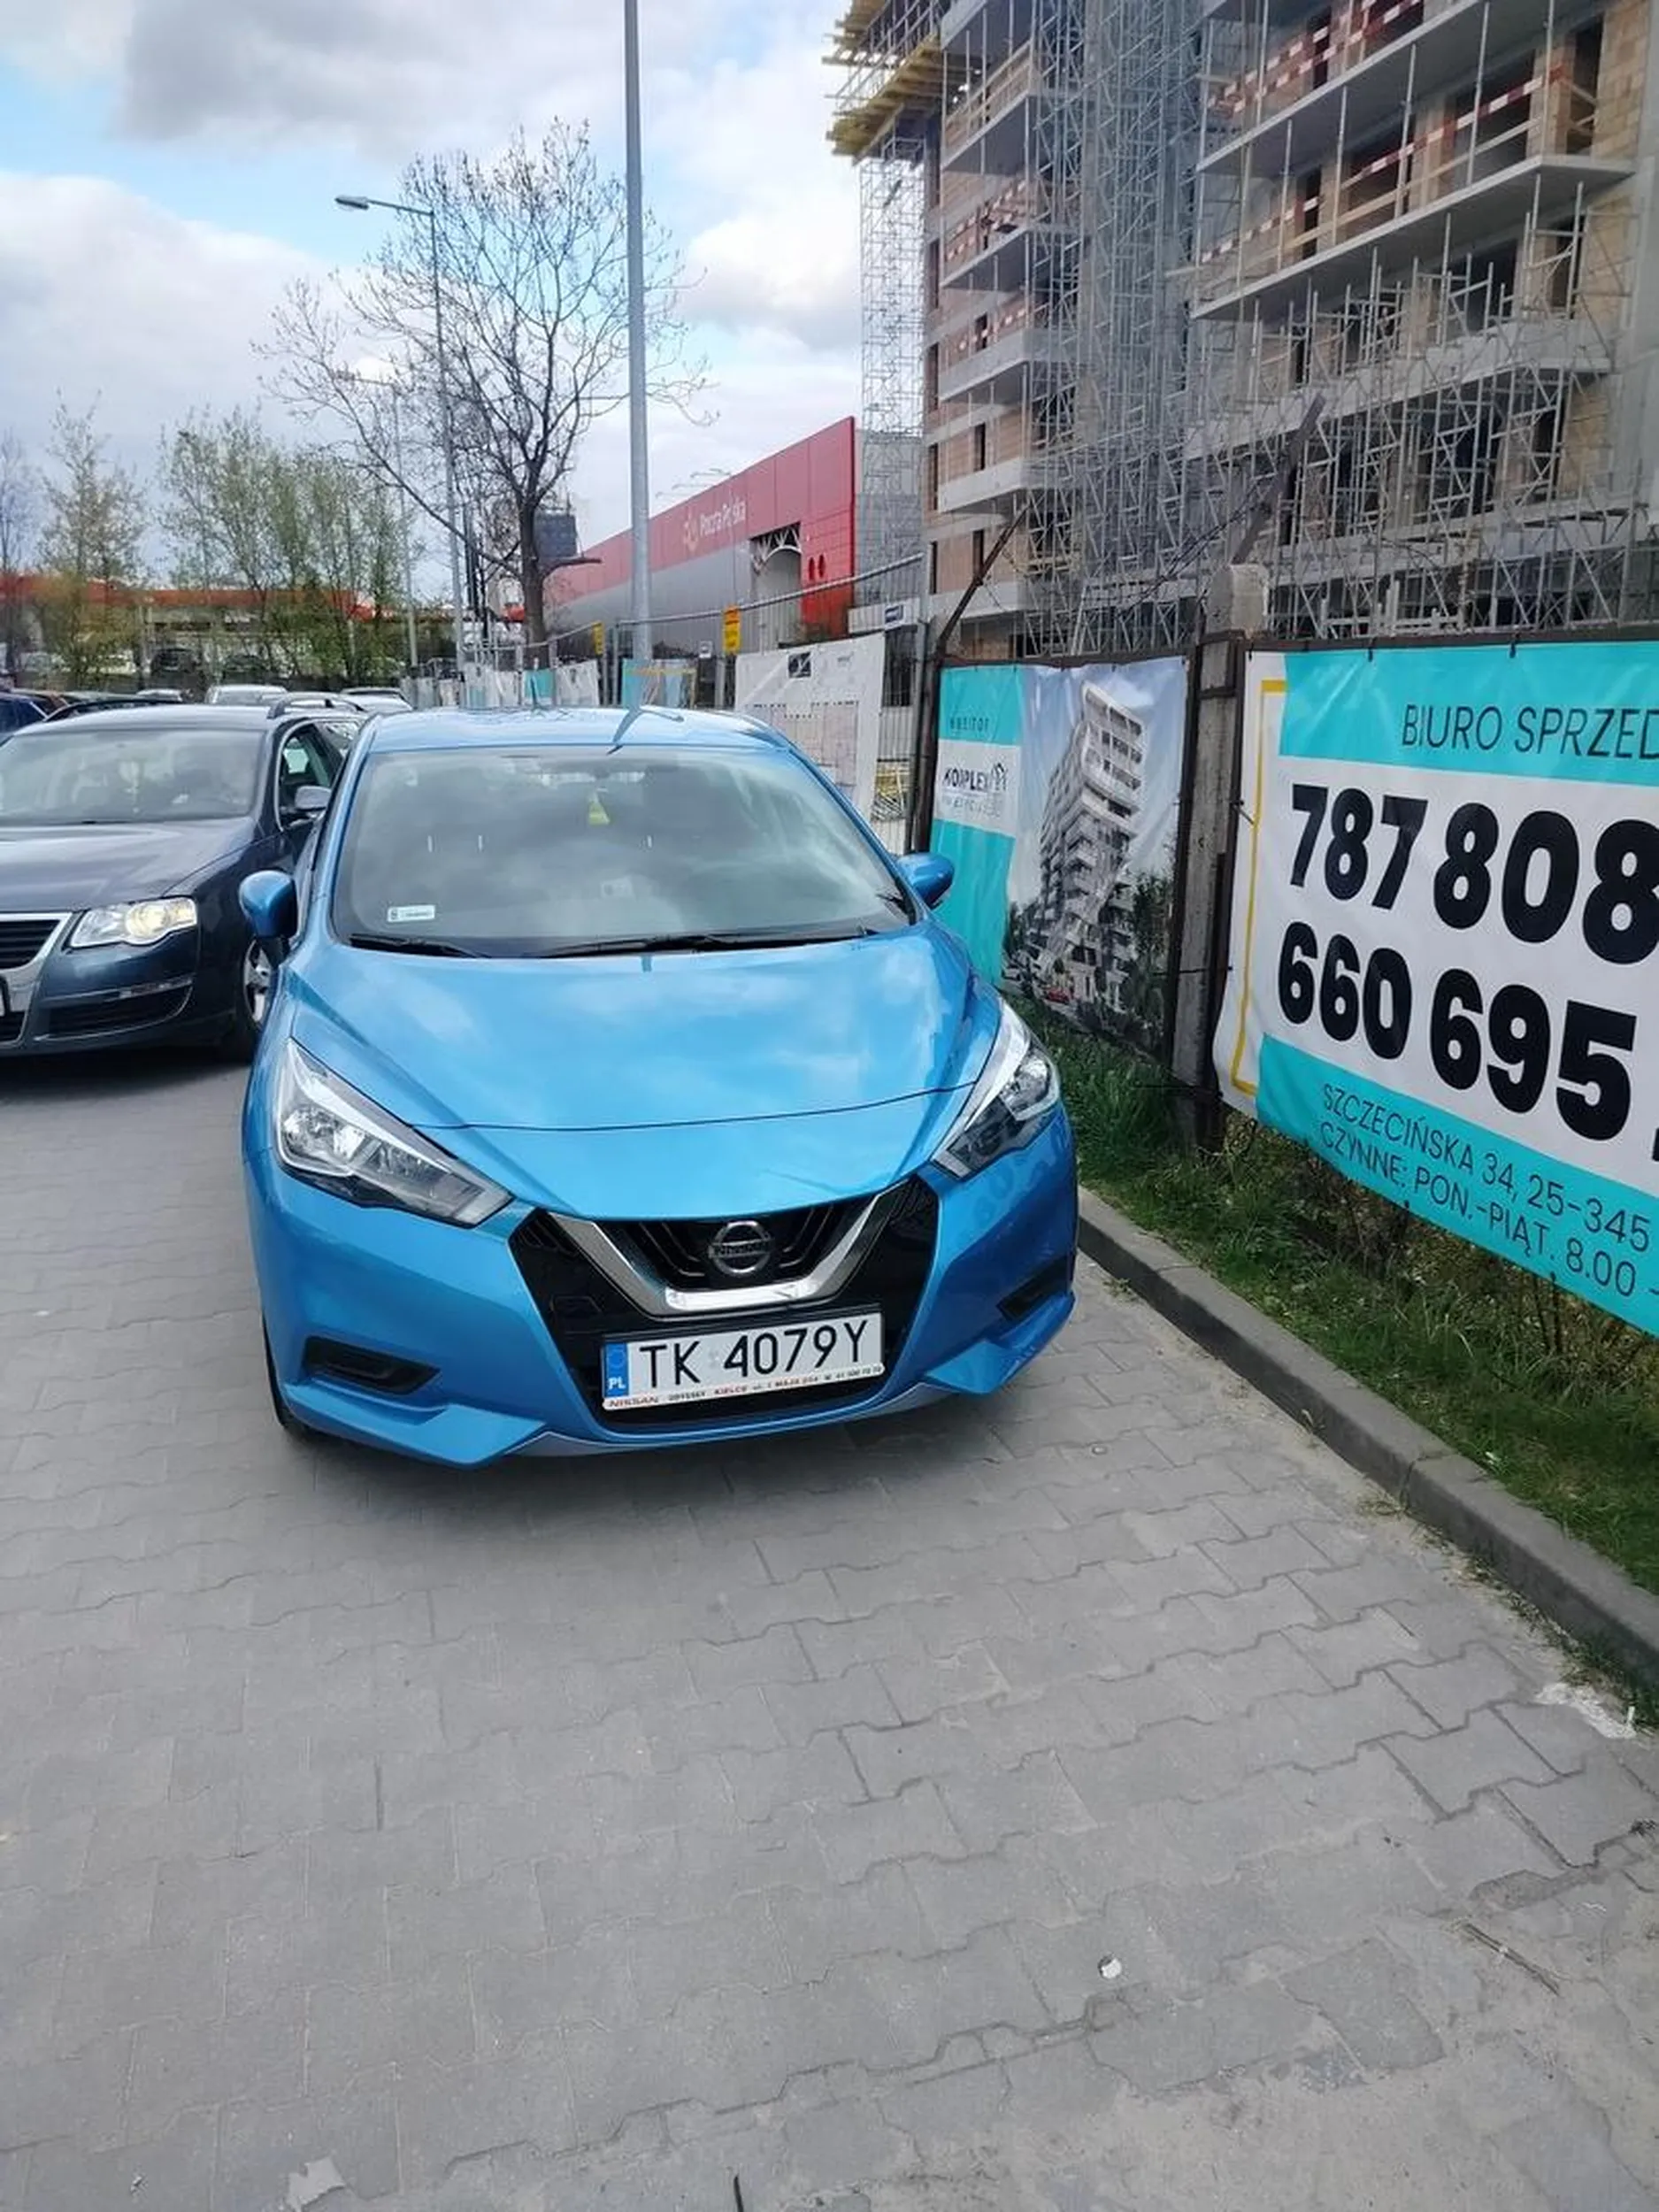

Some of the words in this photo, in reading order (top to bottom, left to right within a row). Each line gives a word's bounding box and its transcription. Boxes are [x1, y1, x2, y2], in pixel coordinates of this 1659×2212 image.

[1402, 704, 1503, 751] BIURO
[1514, 707, 1659, 760] SPRZED
[1290, 783, 1428, 910] 787
[1433, 803, 1659, 964] 808
[1278, 921, 1412, 1060] 660
[1430, 968, 1637, 1141] 695
[1319, 1121, 1409, 1189] CZYNNE:
[1565, 1238, 1636, 1298] 8.00
[1323, 1083, 1474, 1175] SZCZECIŃSKA
[1484, 1153, 1518, 1204] 34,
[1527, 1174, 1651, 1253] 25-345
[607, 1377, 626, 1390] PL
[639, 1340, 701, 1388] TK
[723, 1319, 868, 1379] 4079Y
